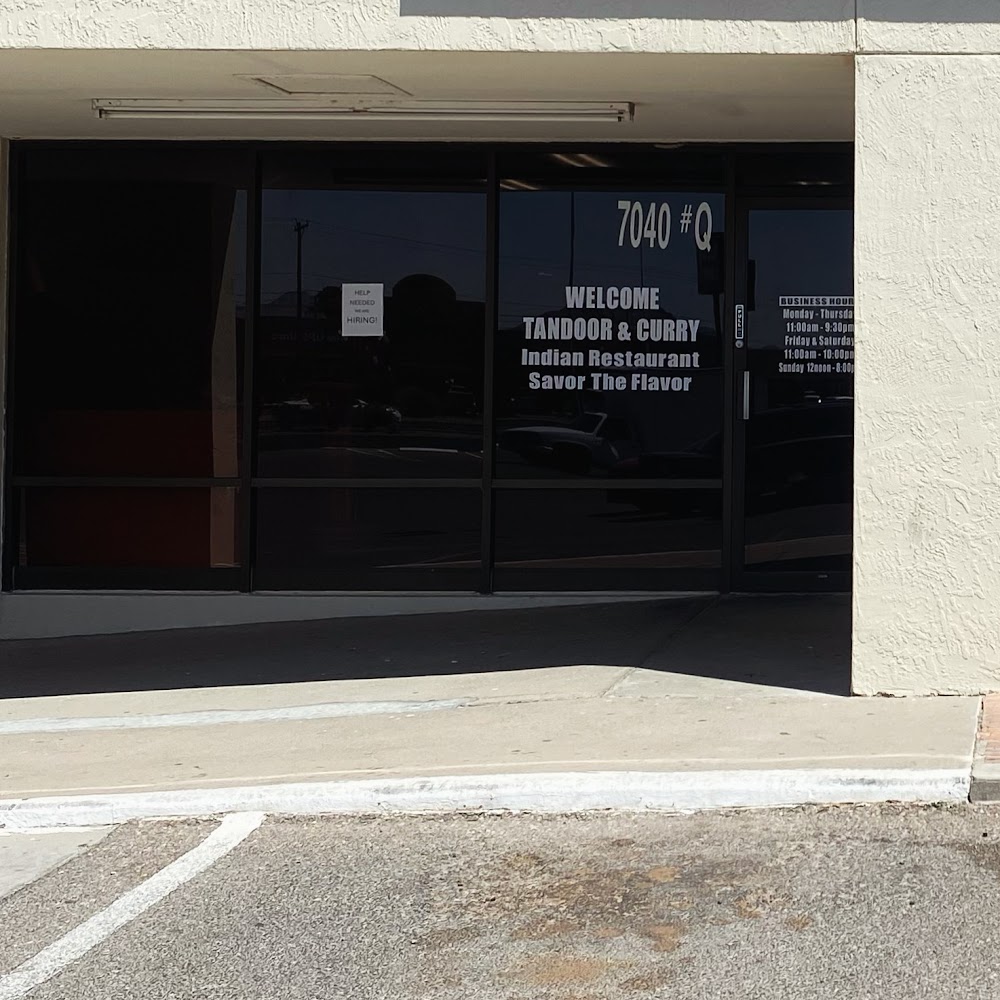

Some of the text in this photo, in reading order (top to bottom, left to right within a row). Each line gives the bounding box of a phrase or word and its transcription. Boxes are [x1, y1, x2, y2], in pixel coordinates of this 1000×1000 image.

[617, 201, 670, 250] 7040
[566, 286, 660, 310] WELCOME
[781, 297, 854, 306] BUSINESS HOUR
[347, 316, 377, 324] HIRING!
[783, 308, 814, 320] Monday
[820, 308, 854, 319] Thursda
[523, 317, 700, 342] TANDOOR & CURRY
[786, 322, 819, 333] 11:00am
[785, 335, 811, 347] Friday
[812, 337, 818, 346] &
[521, 348, 700, 368] Indian Restaurant
[784, 349, 817, 360] 11:00am
[778, 362, 805, 374] Sunday
[807, 362, 831, 373] 12noon
[529, 371, 692, 392] Savor The Flavor
